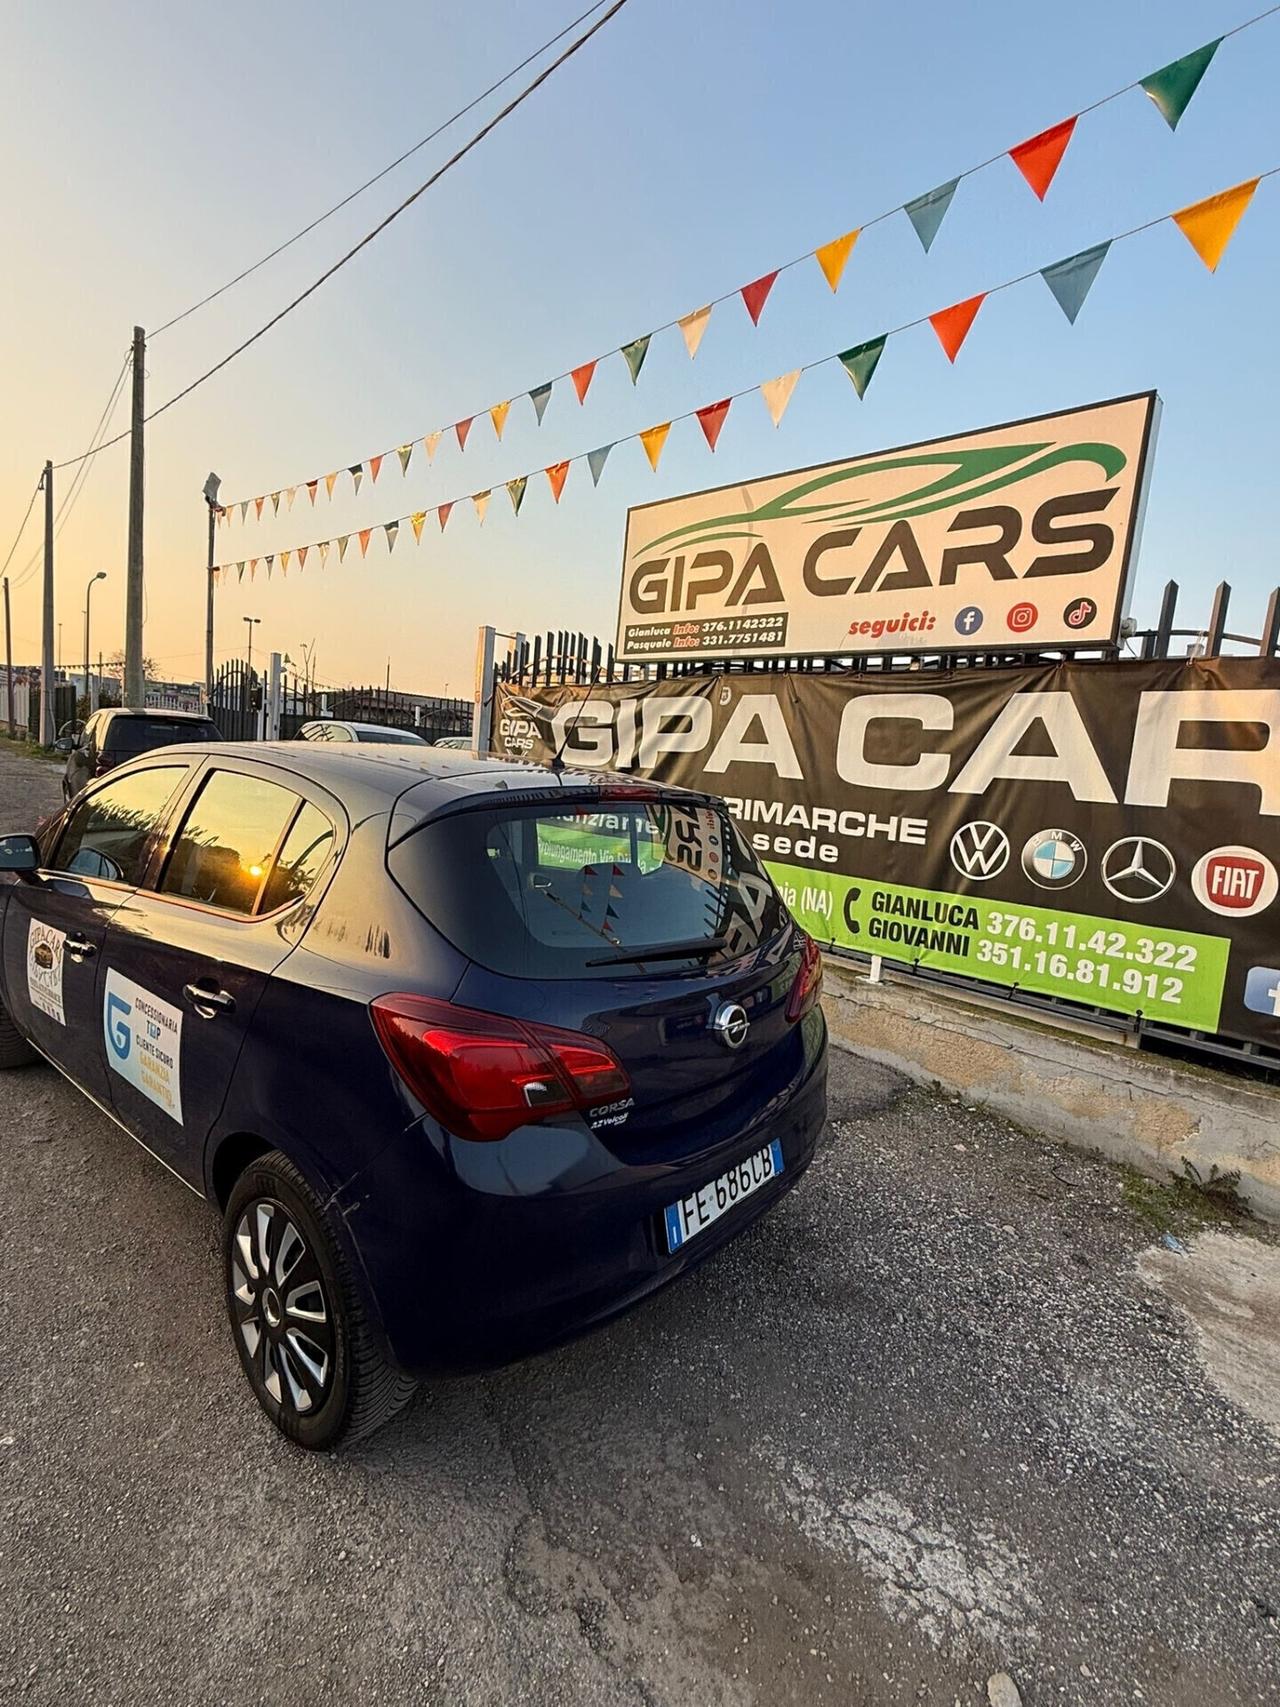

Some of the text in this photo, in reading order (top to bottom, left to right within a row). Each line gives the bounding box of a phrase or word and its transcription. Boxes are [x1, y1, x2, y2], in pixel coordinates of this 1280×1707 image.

[629, 487, 1121, 614] GIPA CARS
[626, 631, 783, 650] Pasquale Info: 331.7751481
[628, 617, 784, 638] Gianluca Info: 376.1142322
[848, 610, 936, 638] seguici:
[500, 719, 542, 739] GIPA
[504, 737, 534, 749] CARS
[552, 694, 804, 780] GIPA
[752, 833, 839, 863] sede
[1211, 864, 1260, 900] FIAT
[801, 882, 833, 921] (NA)
[871, 891, 1199, 972] GIANLUCA 376.11.42.322
[868, 918, 1184, 1004] GIOVANNI 351.16.81.912
[135, 997, 178, 1034] CONCESSIONARIA
[136, 1034, 155, 1057] CLIENTE
[589, 1097, 635, 1117] CORSA
[681, 1192, 710, 1236] FE
[714, 1146, 773, 1210] 686CB
